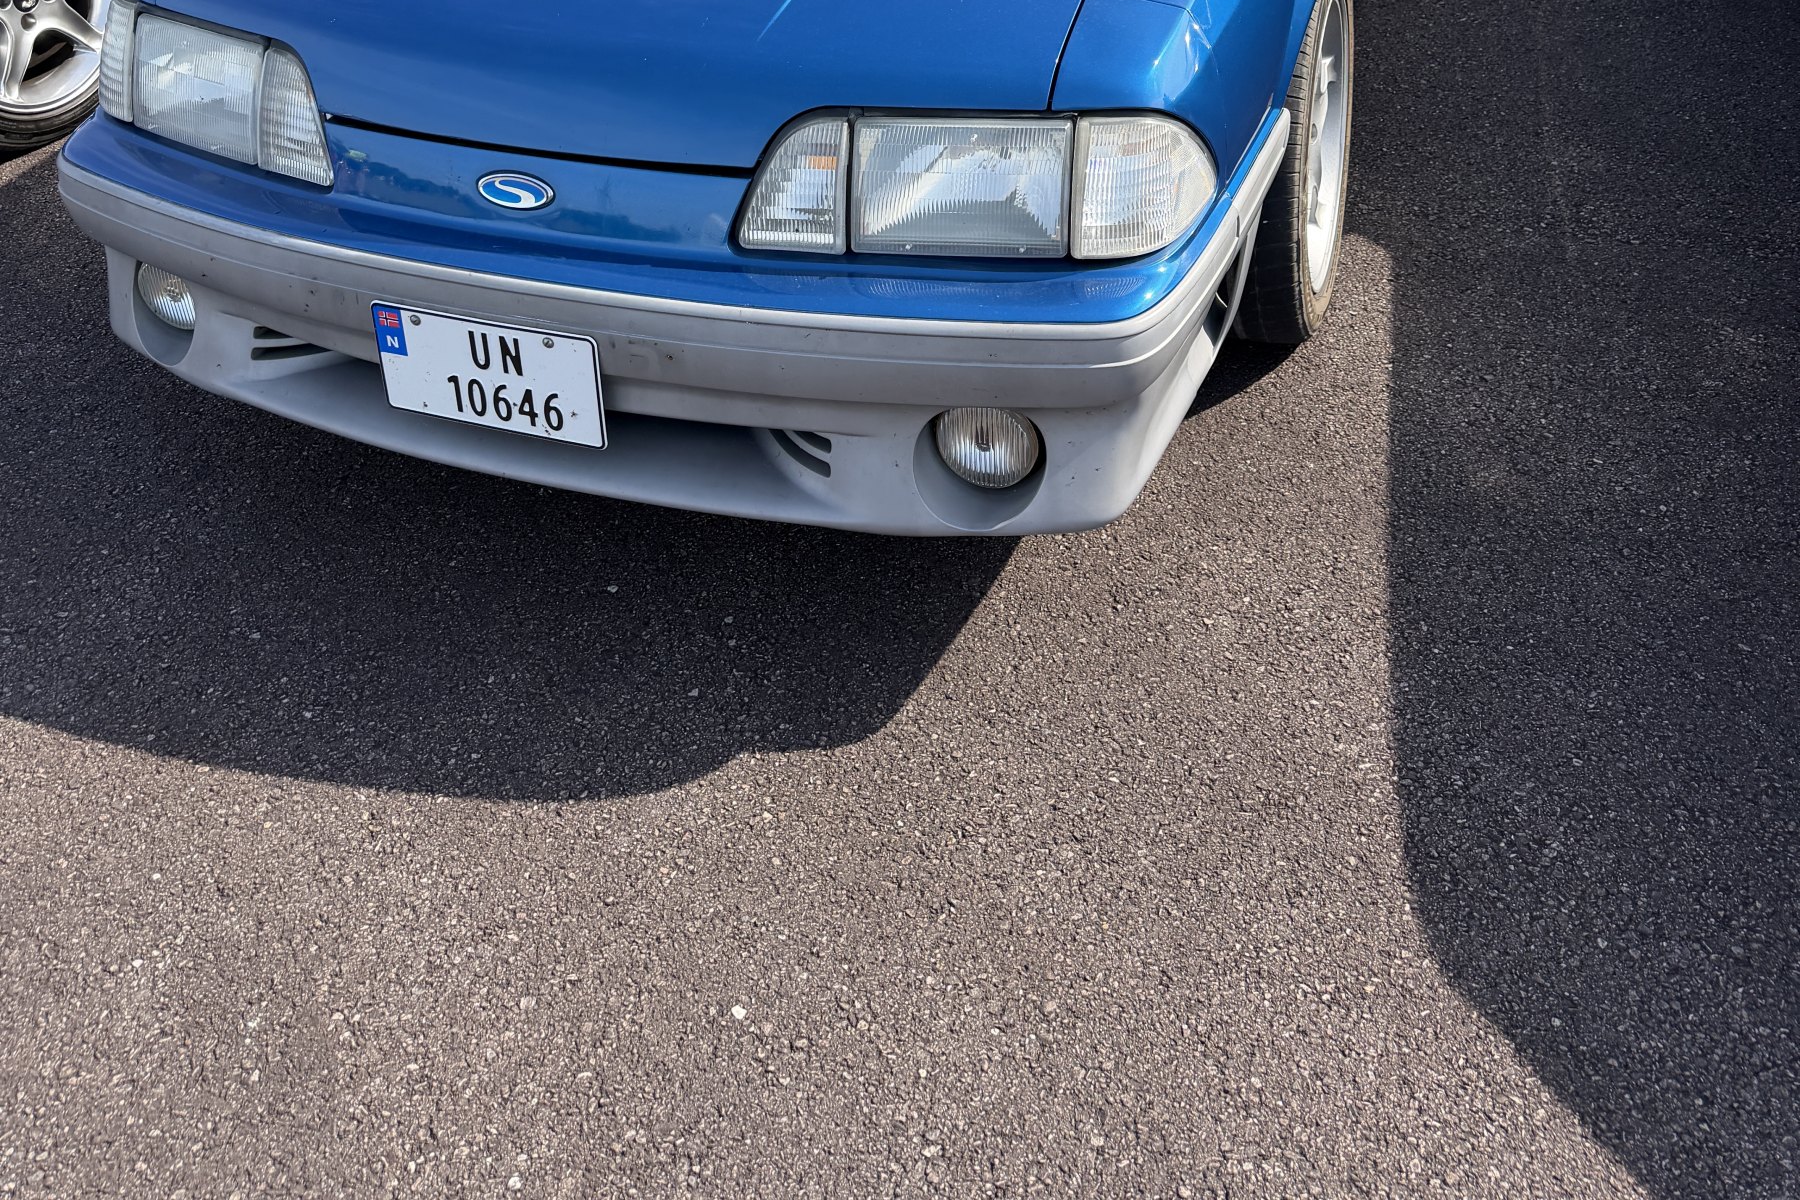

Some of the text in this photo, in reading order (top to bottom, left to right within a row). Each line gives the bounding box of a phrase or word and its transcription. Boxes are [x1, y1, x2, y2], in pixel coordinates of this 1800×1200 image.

[386, 335, 399, 349] N
[467, 330, 524, 377] UN
[447, 375, 564, 431] 10646
